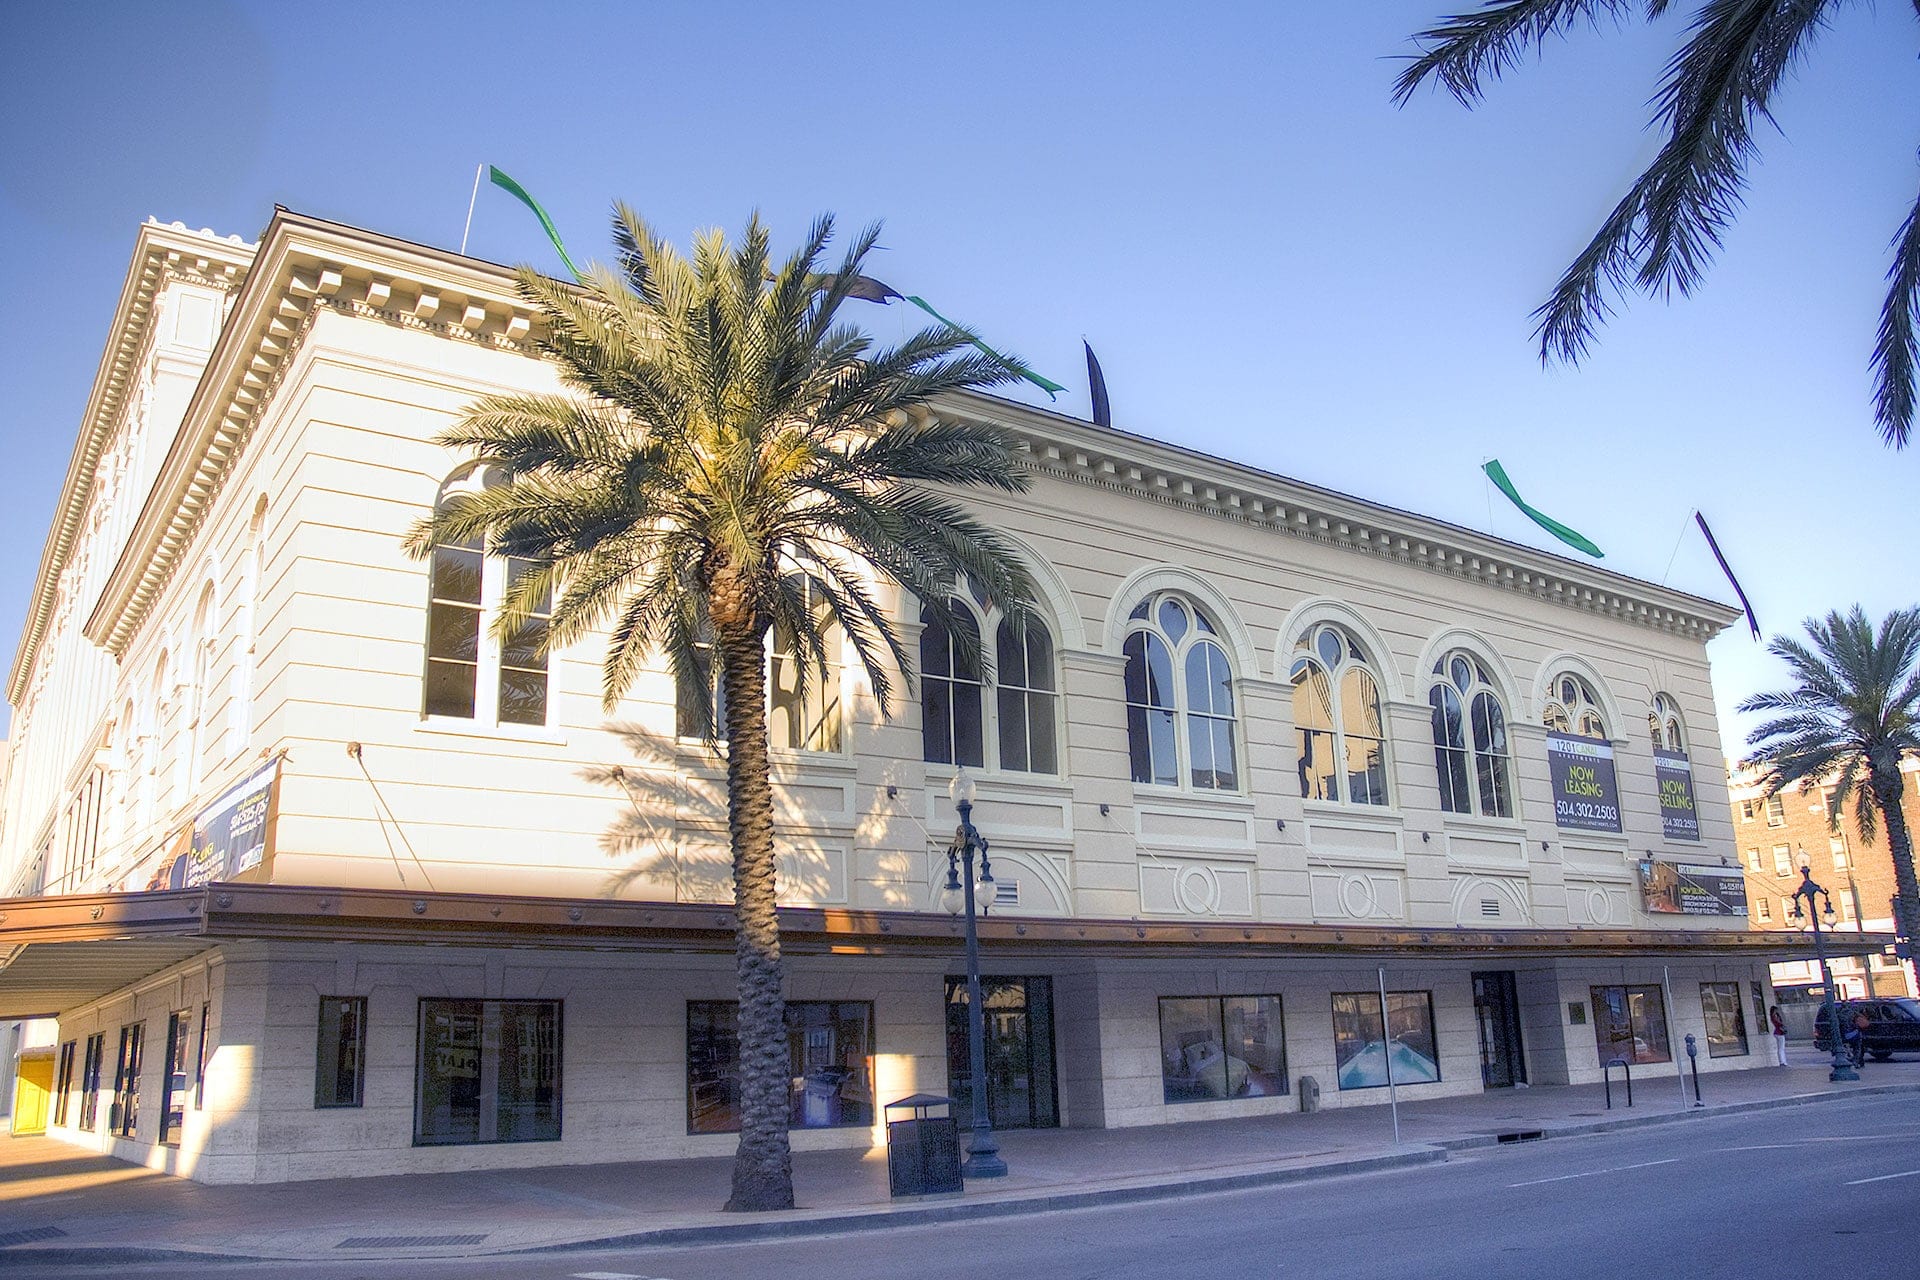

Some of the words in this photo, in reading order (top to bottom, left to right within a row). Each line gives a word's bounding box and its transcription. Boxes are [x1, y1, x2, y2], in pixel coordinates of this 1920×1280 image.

[1569, 765, 1594, 781] NOW
[1564, 779, 1604, 797] LEASING
[1662, 780, 1686, 794] NOW
[1556, 800, 1617, 820] 504.302.2503
[1660, 793, 1693, 810] SELLING
